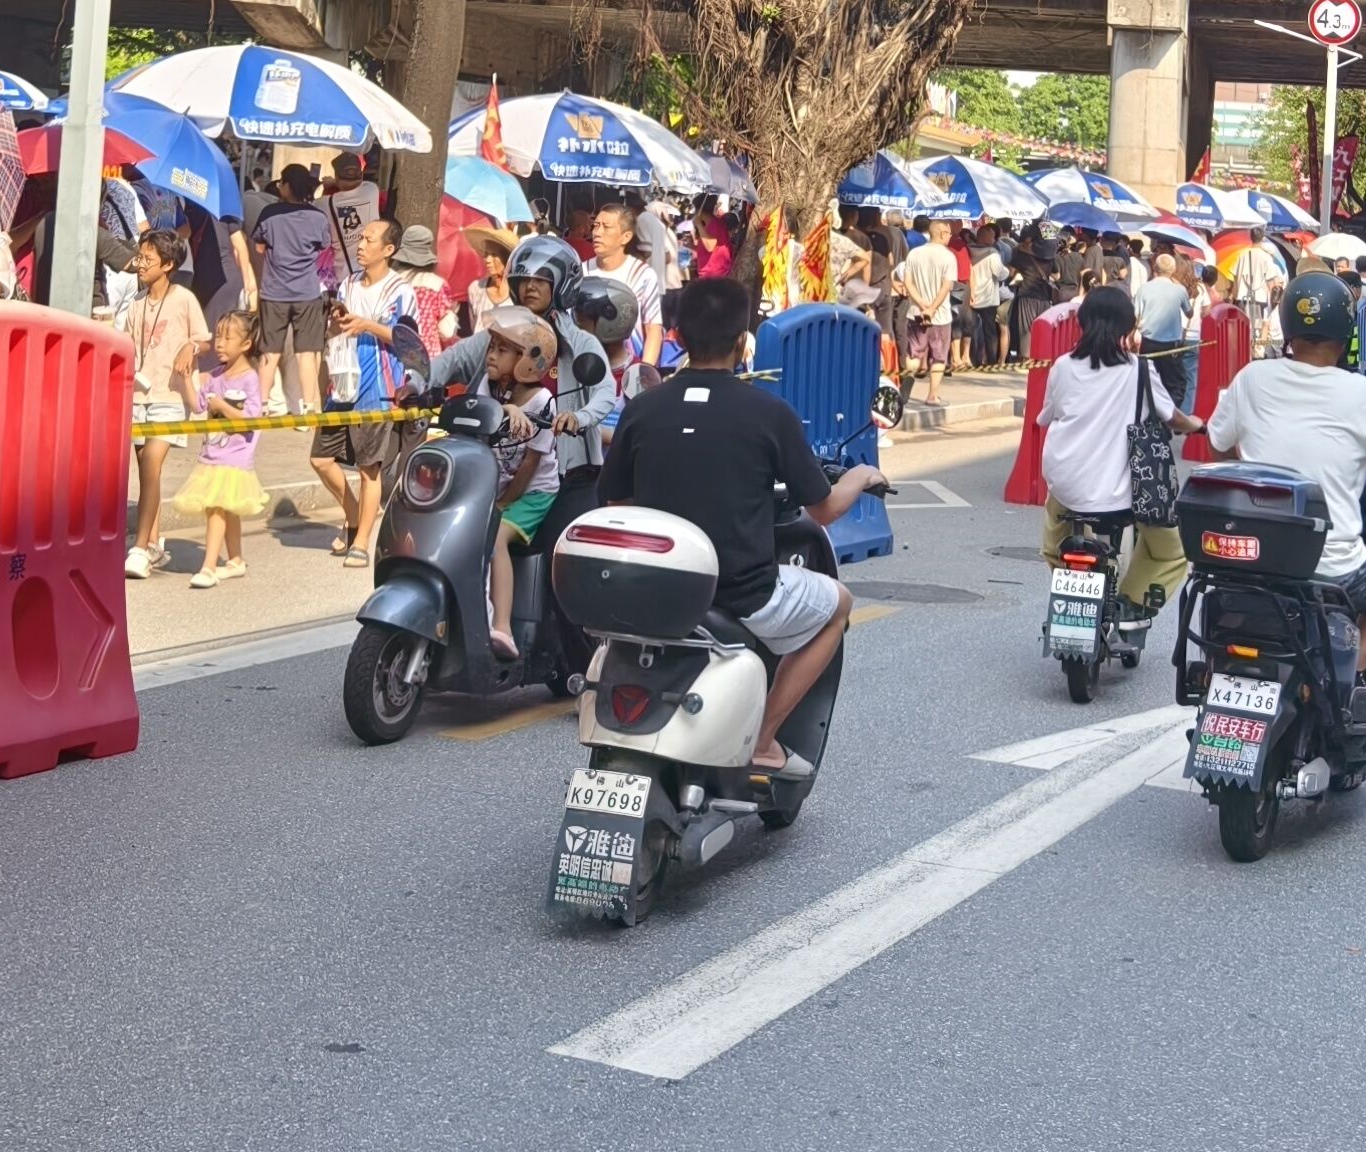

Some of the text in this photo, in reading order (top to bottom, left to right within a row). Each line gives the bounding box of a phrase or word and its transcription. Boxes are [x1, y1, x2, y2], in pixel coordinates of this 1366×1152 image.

[239, 118, 352, 141] 快速补充电解质
[557, 136, 630, 156] 补水啦
[549, 162, 641, 181] 快速补充电解质
[1218, 546, 1256, 558] 小心追尾
[9, 553, 27, 581] 察
[1055, 579, 1100, 596] C46446
[1066, 601, 1098, 618] 雅迪
[1212, 688, 1274, 710] X47136
[570, 786, 642, 812] K97698
[584, 829, 636, 861] 雅迪
